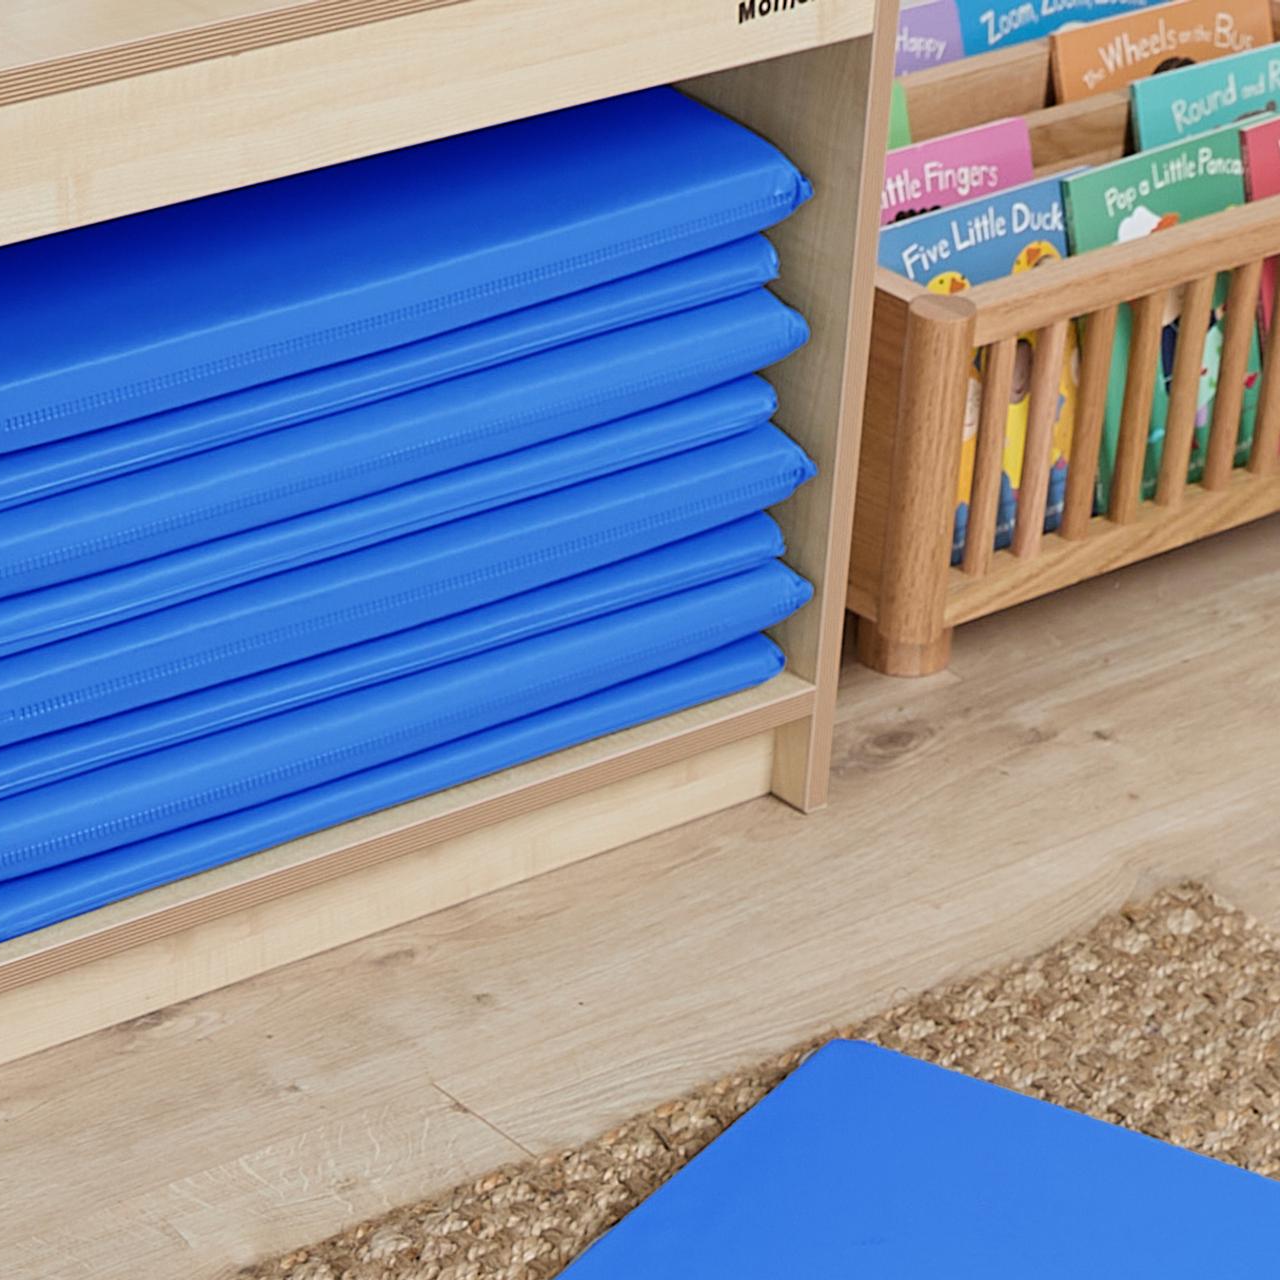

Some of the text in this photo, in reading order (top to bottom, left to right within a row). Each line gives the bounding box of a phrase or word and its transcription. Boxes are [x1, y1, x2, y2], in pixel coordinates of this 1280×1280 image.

[896, 27, 946, 60] Happy
[1099, 18, 1178, 74] Wheels
[1171, 73, 1238, 133] Round
[1241, 74, 1265, 99] and
[924, 161, 998, 196] Fingers
[1105, 187, 1137, 217] Pop
[1151, 152, 1197, 190] Little
[902, 239, 951, 279] Five
[951, 206, 1007, 251] Little
